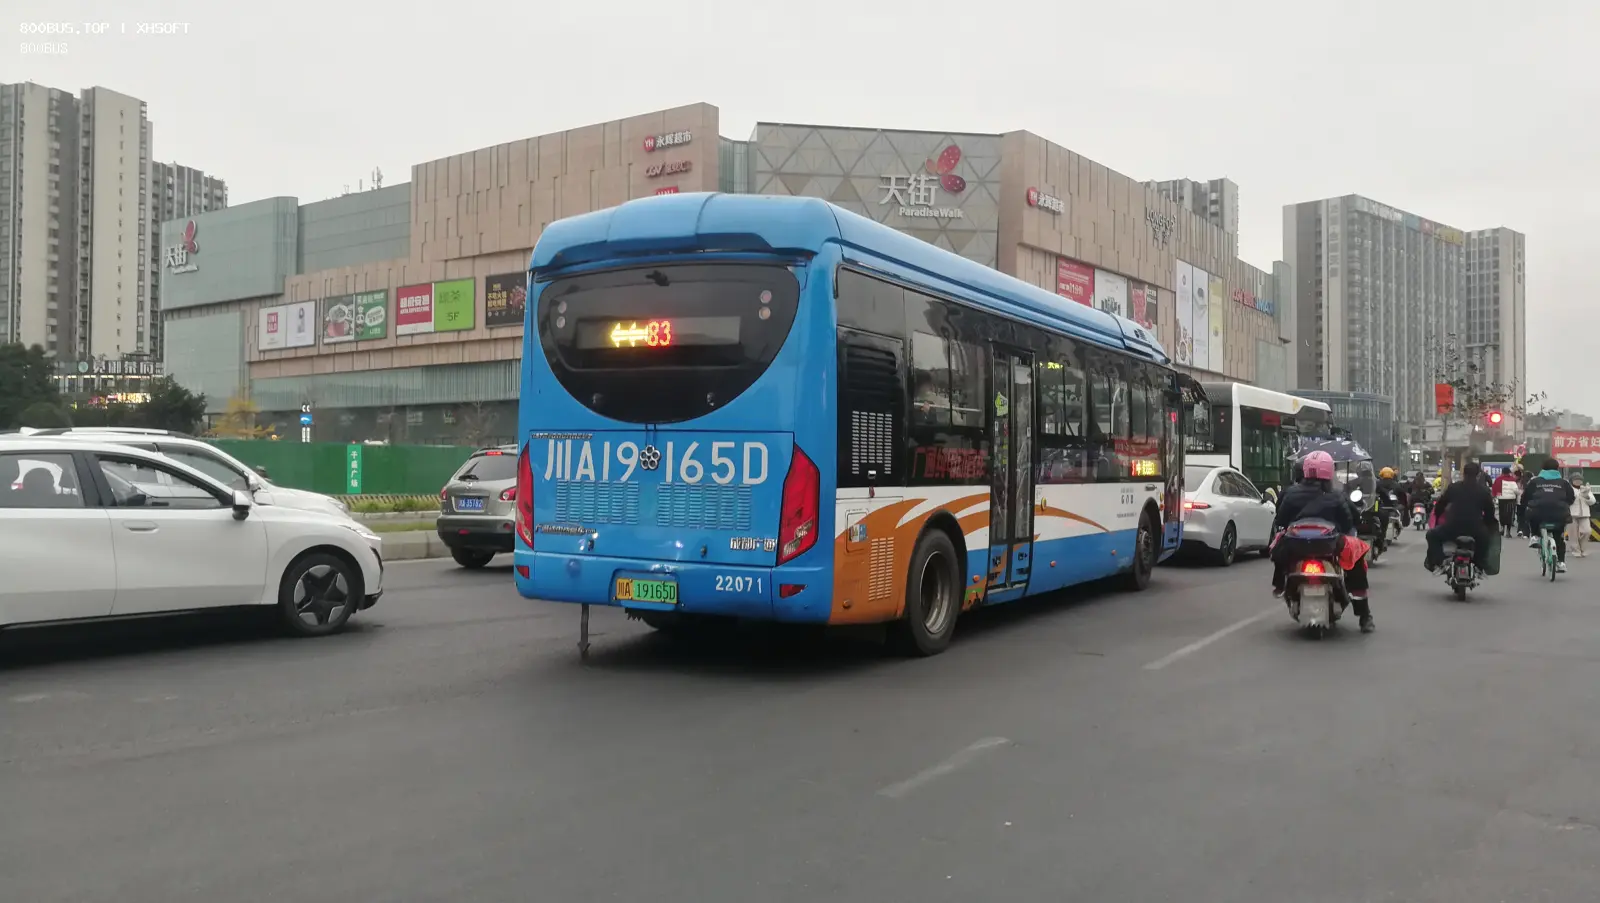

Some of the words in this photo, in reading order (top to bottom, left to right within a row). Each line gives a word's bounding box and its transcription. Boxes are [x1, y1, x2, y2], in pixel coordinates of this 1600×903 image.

[656, 131, 692, 148] 永辉超市
[878, 174, 939, 206] 天街
[447, 311, 460, 322] 5F
[647, 320, 672, 347] 83
[544, 439, 639, 482] 川A19
[665, 441, 769, 485] 165D
[616, 580, 632, 599] 川A
[636, 582, 676, 601] 19165D
[715, 574, 762, 594] 22071
